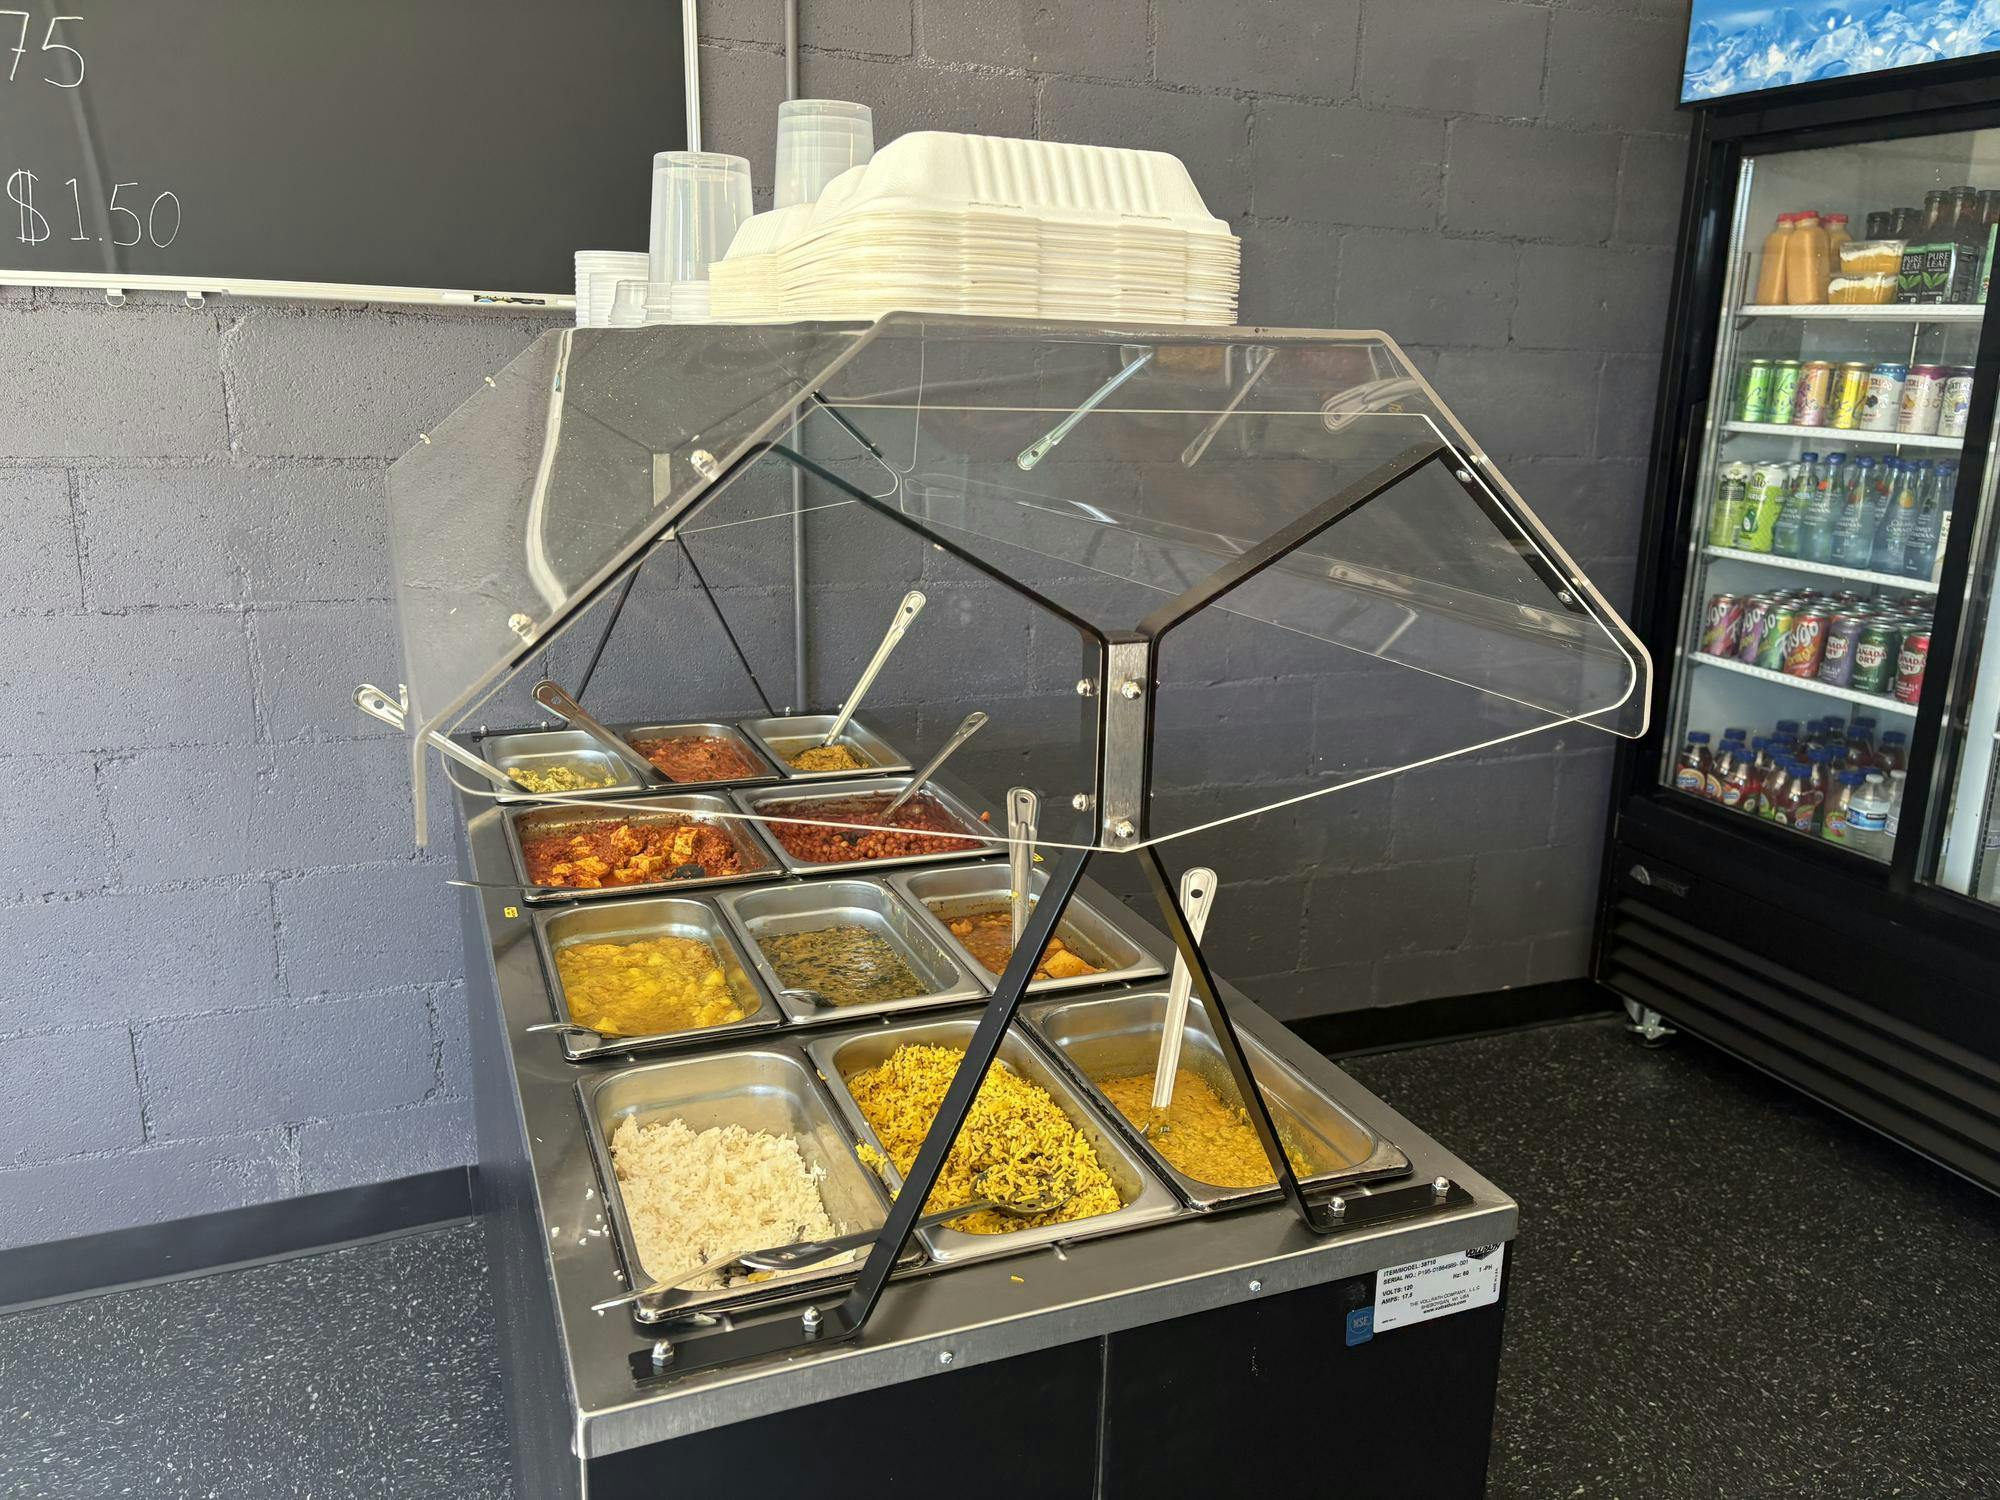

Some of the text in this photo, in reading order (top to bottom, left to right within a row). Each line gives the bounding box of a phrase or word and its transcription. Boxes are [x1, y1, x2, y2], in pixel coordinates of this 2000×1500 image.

[1903, 255, 1922, 264] PURE
[1928, 251, 1951, 261] PURE
[1901, 262, 1920, 272] LEAF
[1926, 260, 1948, 269] LEAF
[1775, 620, 1819, 661] Faygo
[1857, 647, 1887, 660] ANADA
[1858, 655, 1877, 665] DRY
[1383, 1274, 1403, 1284] SERIAL
[1382, 1286, 1402, 1296] VOLTS:
[1381, 1295, 1399, 1304] AMPS:
